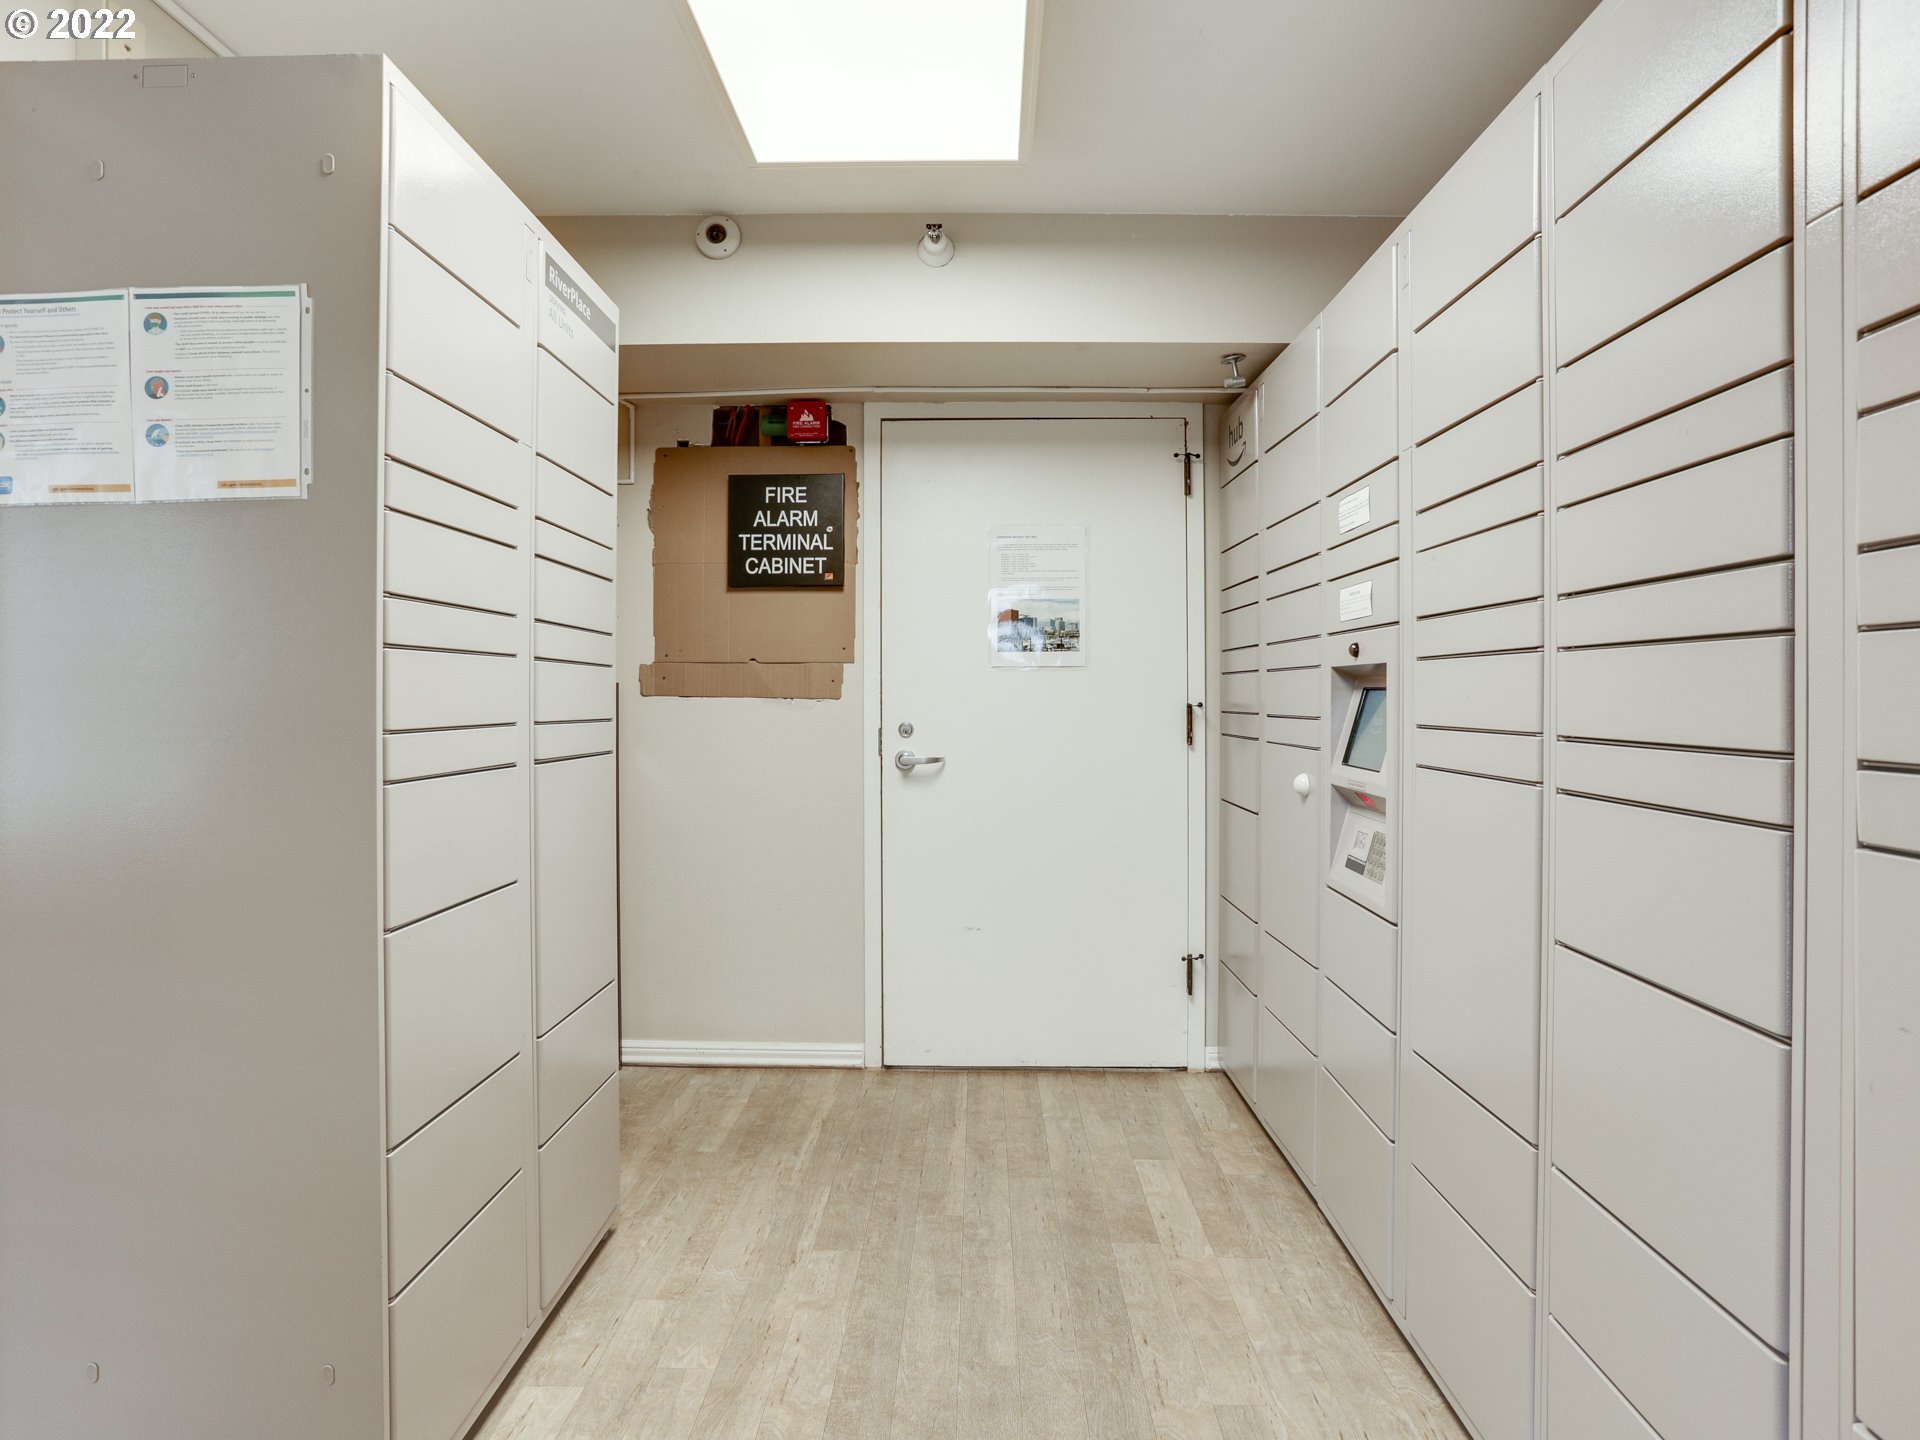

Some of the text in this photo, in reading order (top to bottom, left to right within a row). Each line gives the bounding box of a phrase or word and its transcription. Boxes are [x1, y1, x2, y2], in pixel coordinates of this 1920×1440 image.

[549, 265, 591, 320] RiverPlace
[1228, 416, 1244, 449] hub
[765, 486, 807, 504] FIRE
[753, 510, 818, 527] ALARM
[739, 533, 834, 551] TERMINAL
[745, 557, 827, 575] CABINET
